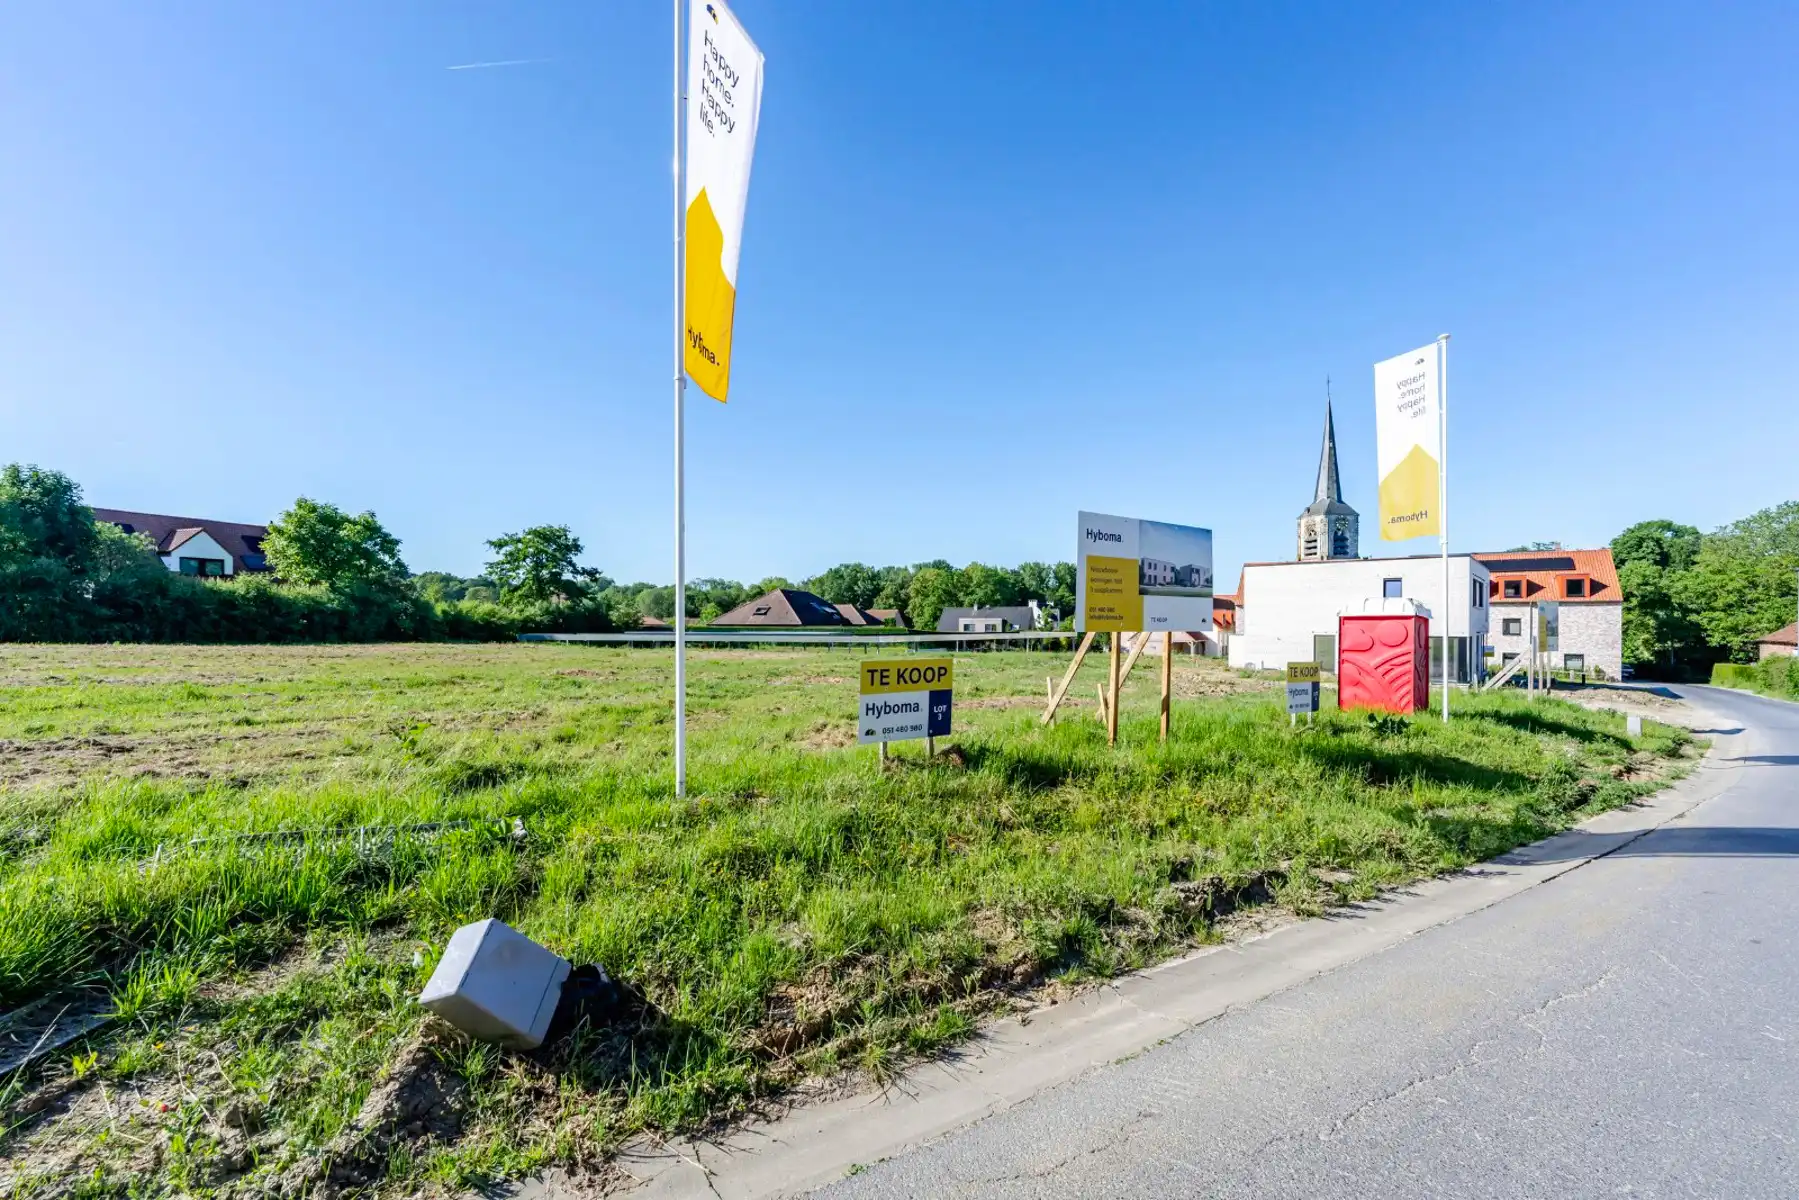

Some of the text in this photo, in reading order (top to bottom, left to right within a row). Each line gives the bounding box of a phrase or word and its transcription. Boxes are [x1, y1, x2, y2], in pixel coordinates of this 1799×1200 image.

[704, 29, 740, 88] Happy
[703, 53, 734, 108] home.
[702, 78, 736, 134] Happy
[700, 101, 715, 138] life.
[1086, 528, 1124, 543] Hyboma.
[866, 666, 948, 687] TE KOOP
[1289, 666, 1319, 678] TE KOOP
[865, 700, 924, 720] Hyboma.
[933, 704, 948, 713] LOT
[882, 726, 894, 735] 051
[895, 725, 908, 733] 480
